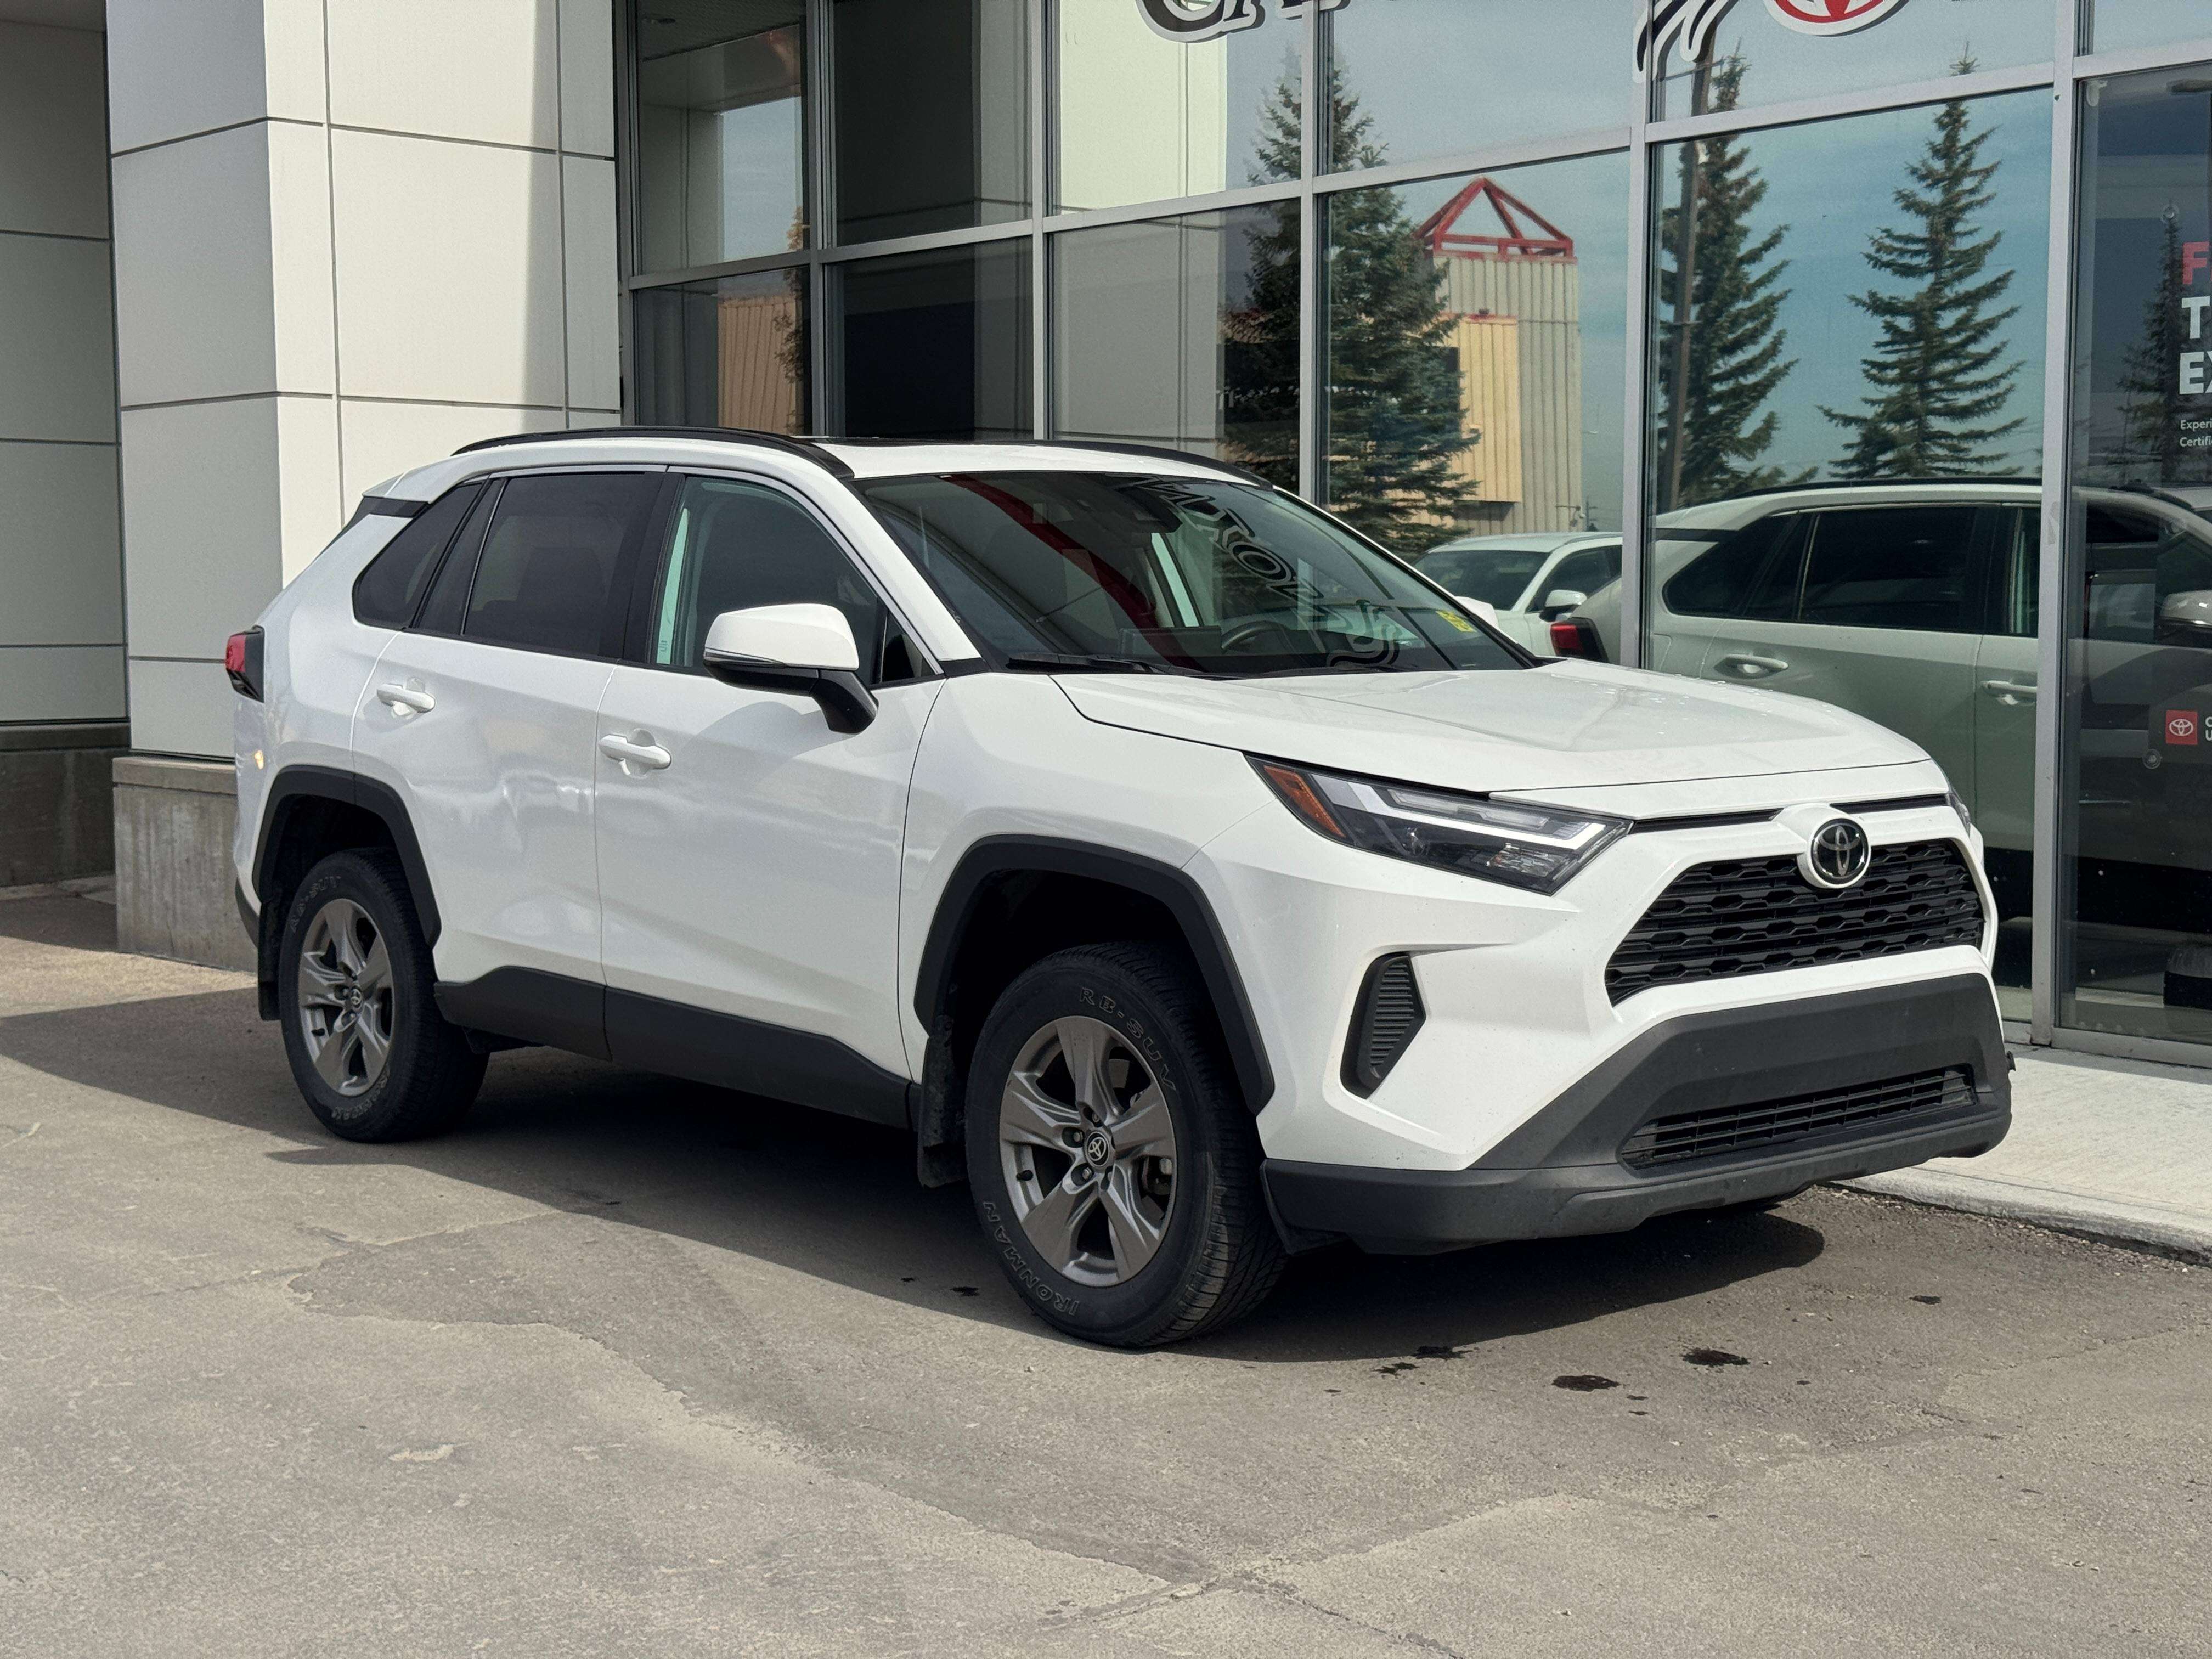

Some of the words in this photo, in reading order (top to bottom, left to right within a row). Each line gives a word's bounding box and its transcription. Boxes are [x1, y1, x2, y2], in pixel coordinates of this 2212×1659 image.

[2182, 241, 2212, 285] F
[2179, 436, 2212, 447] Certifi
[1079, 987, 1177, 1092] RB-SUV
[981, 1200, 1080, 1317] IRONMAN
